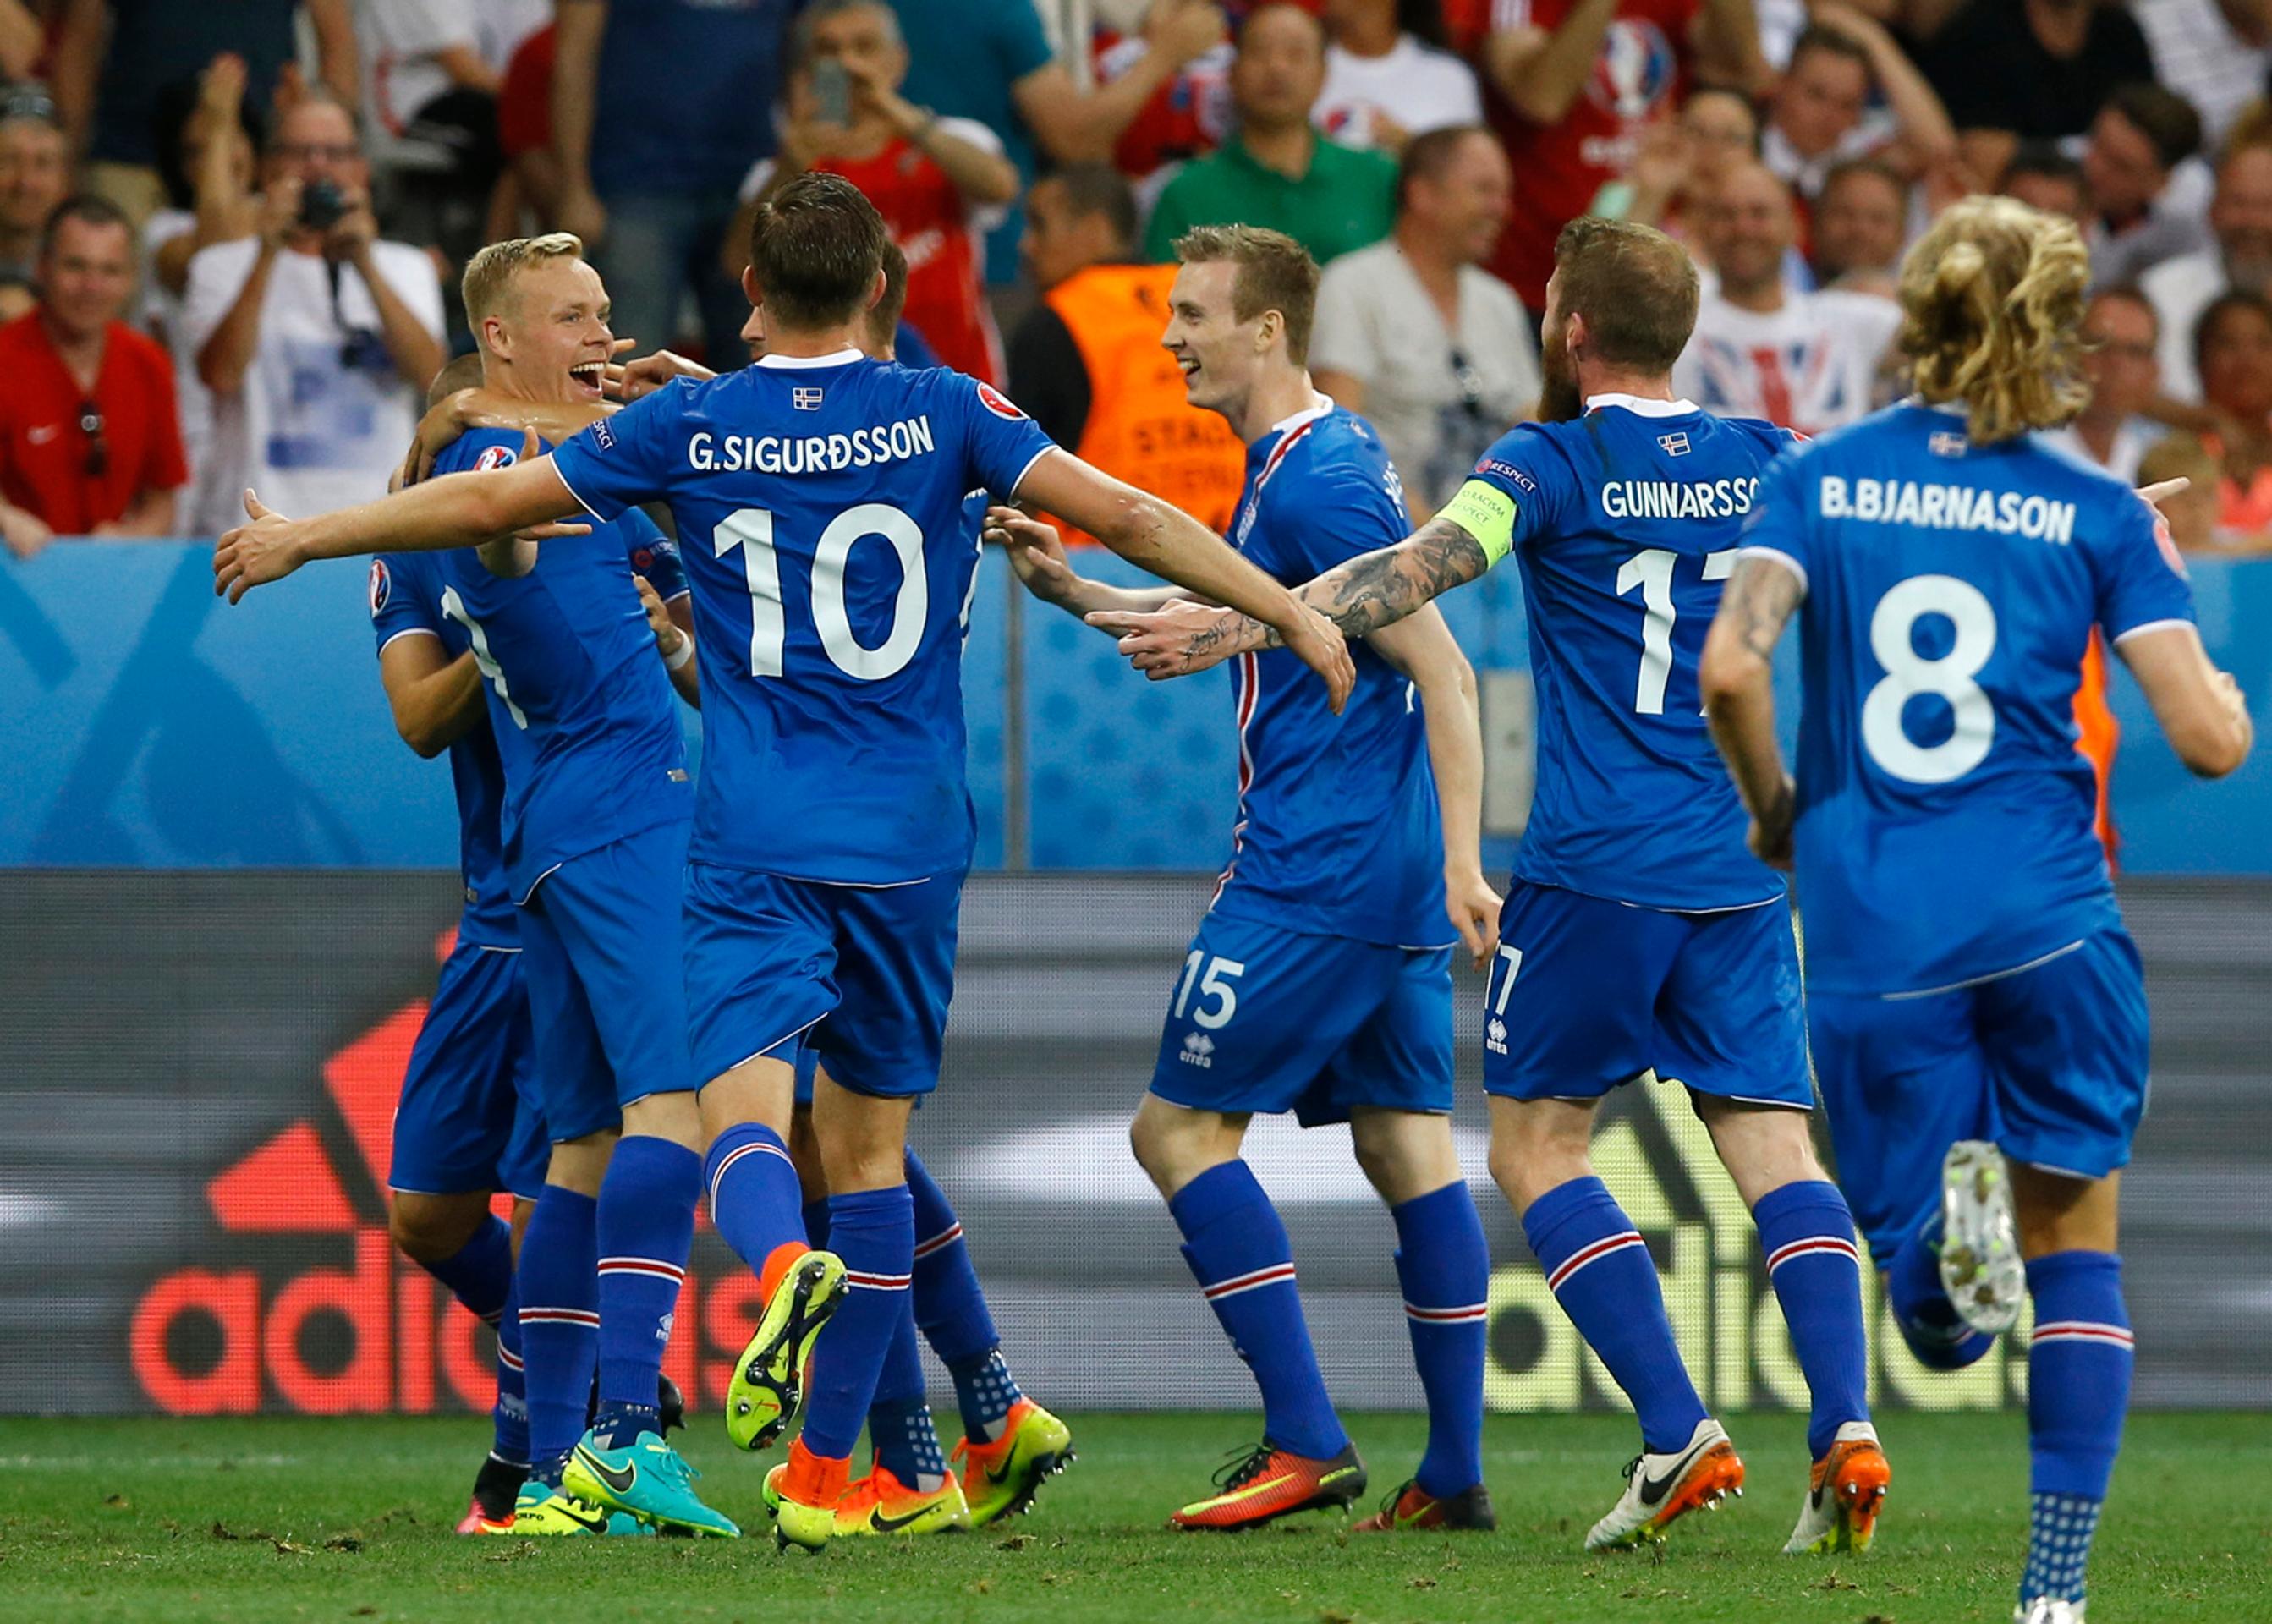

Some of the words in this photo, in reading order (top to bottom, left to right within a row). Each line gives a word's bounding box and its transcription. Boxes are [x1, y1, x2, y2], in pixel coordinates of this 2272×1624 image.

[689, 415, 934, 474] G.SIGURÐSSON
[1490, 462, 1536, 492] RESPECT
[1820, 476, 2076, 546] B.BJARNASON
[713, 503, 928, 680] 10
[1862, 574, 1997, 783] 8
[1174, 949, 1245, 1029] 15
